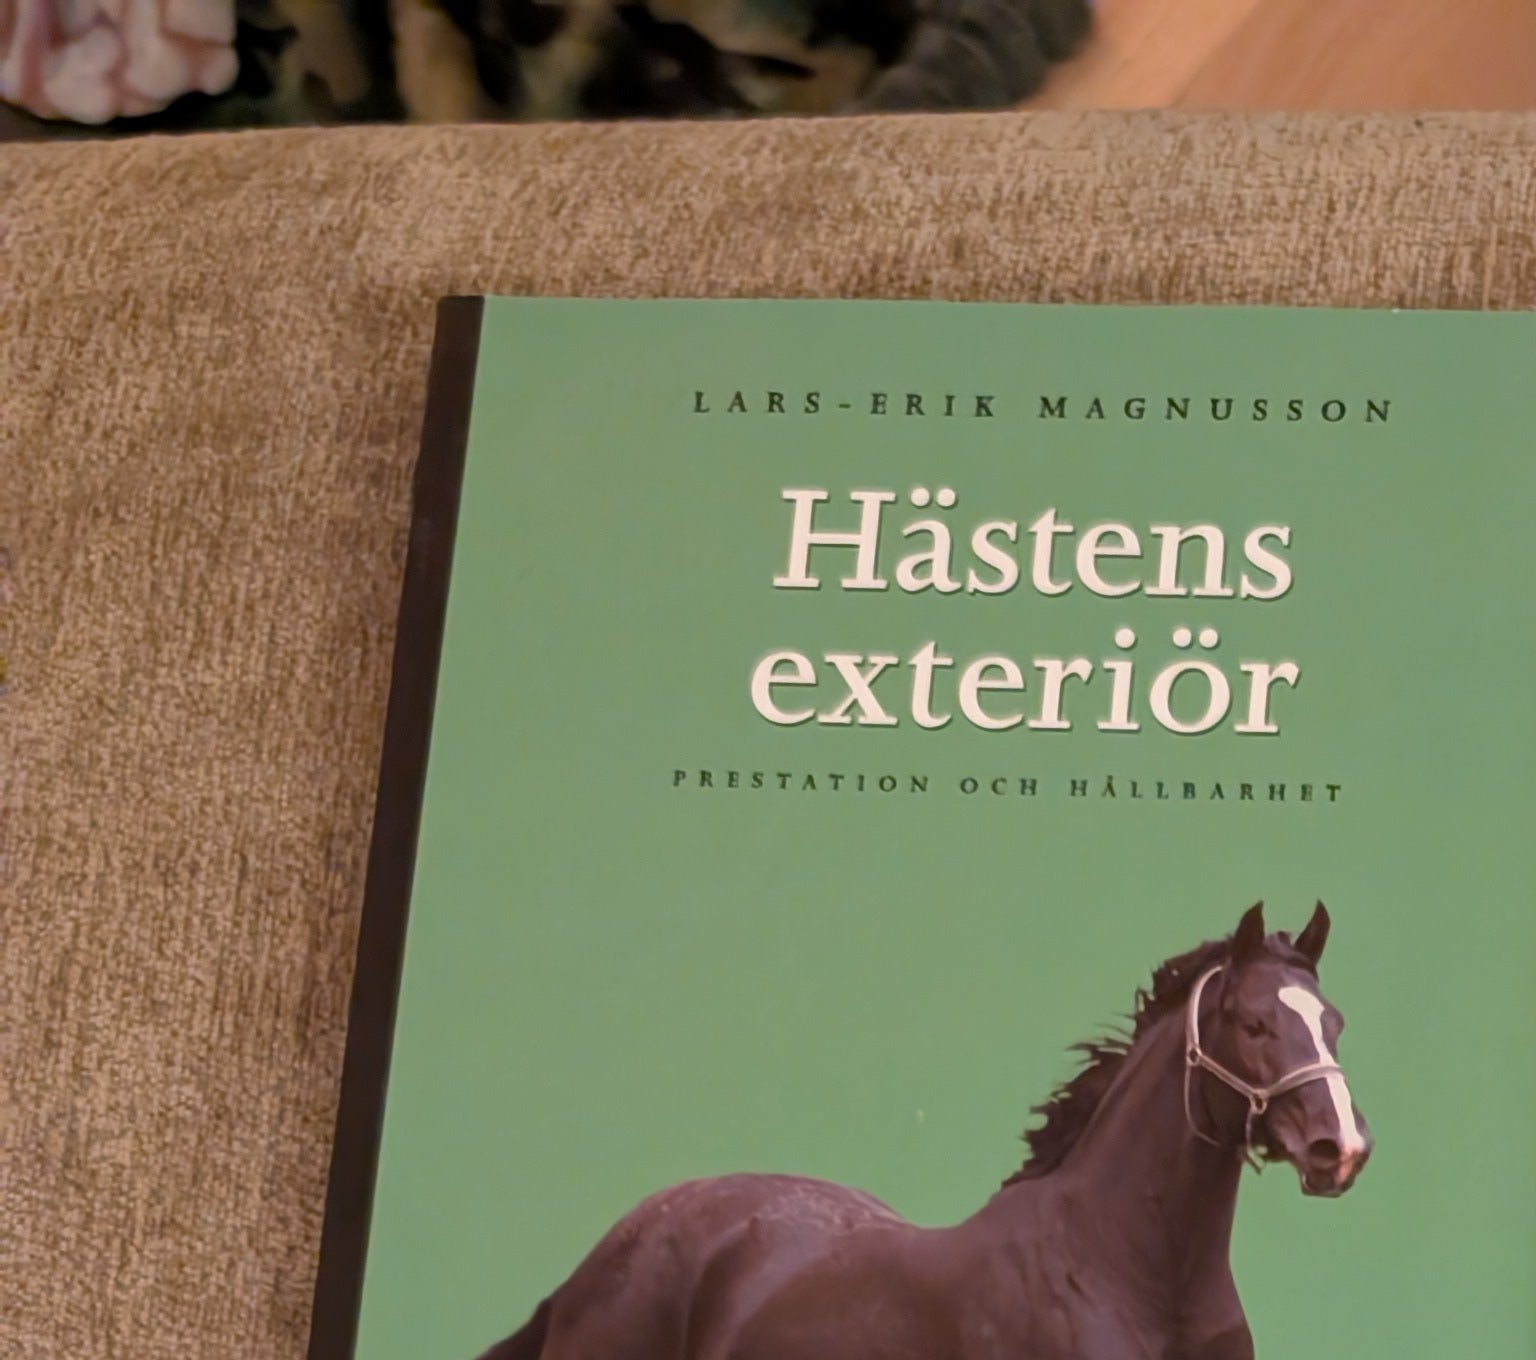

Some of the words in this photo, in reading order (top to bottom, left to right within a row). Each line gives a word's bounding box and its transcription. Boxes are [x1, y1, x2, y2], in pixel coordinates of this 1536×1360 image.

[693, 390, 999, 419] LARS-ERIK
[1038, 395, 1396, 424] MAGNUSSON
[771, 486, 1296, 601] Hästens
[749, 626, 1301, 736] exteriör
[672, 769, 929, 795] PRESTATION
[960, 777, 1038, 798] OCH
[1069, 774, 1343, 803] HÅLLBARHET
